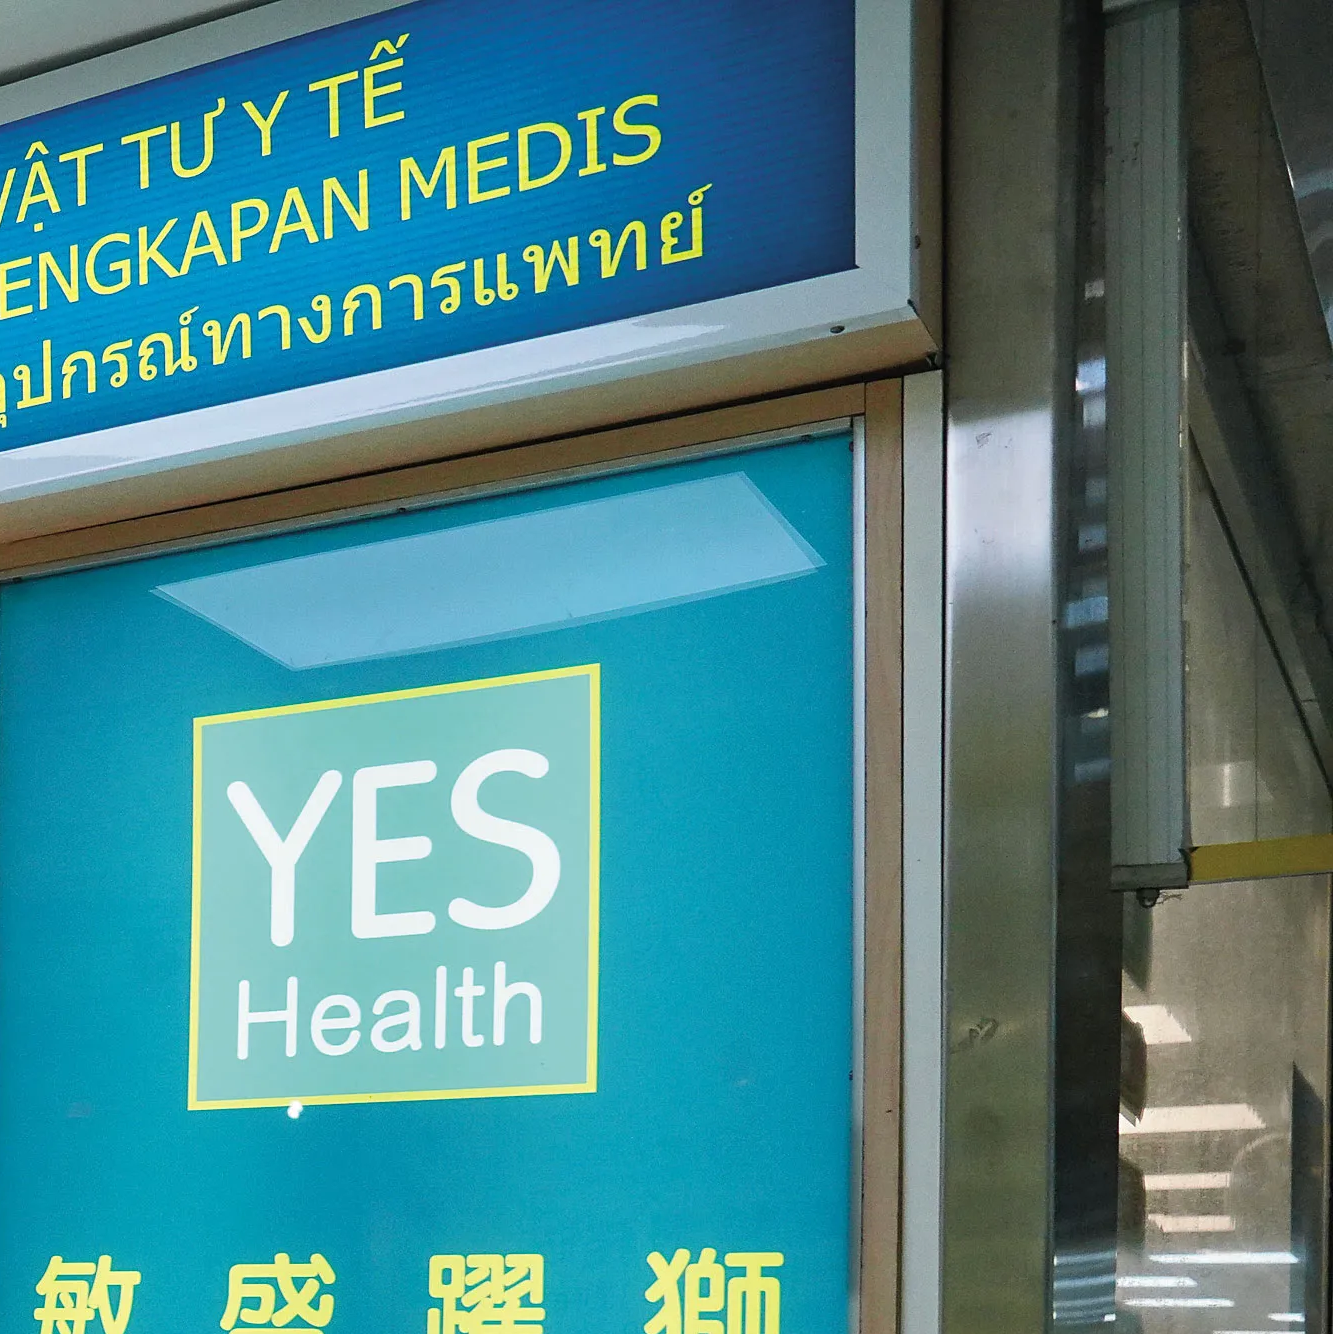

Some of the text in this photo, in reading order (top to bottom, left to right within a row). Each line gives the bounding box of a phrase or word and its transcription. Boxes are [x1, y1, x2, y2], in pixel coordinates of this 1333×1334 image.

[122, 97, 226, 186] TƯ
[240, 91, 291, 155] Y
[310, 31, 410, 141] TẾ
[399, 92, 663, 225] MEDIS
[227, 748, 562, 948] YES
[236, 961, 543, 1060] Health
